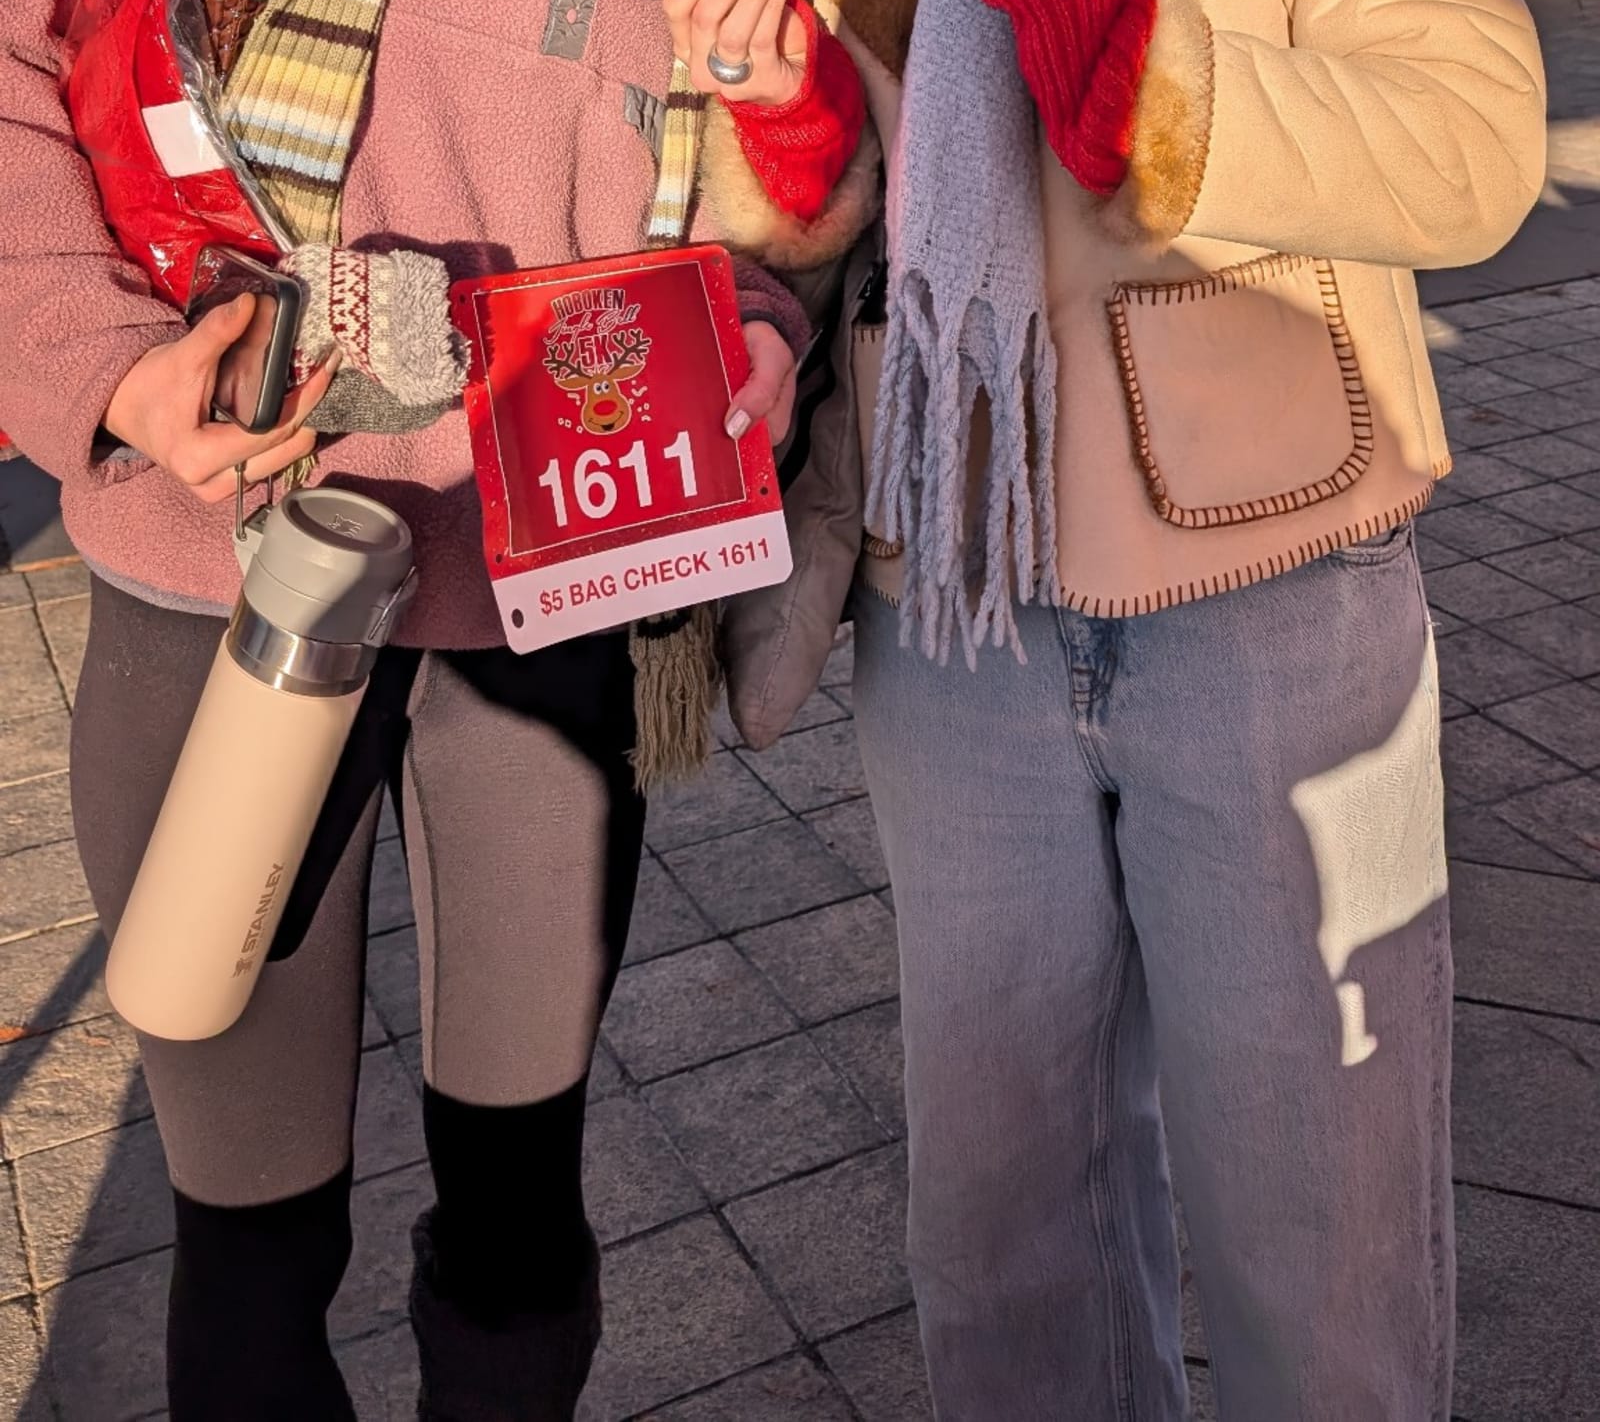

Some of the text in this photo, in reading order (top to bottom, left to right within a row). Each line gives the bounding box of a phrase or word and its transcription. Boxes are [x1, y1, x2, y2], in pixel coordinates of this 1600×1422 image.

[543, 304, 641, 344] Jingle Bell
[551, 288, 626, 321] HOBOKEN
[579, 334, 613, 367] 5K
[538, 430, 699, 528] 1611
[540, 538, 770, 617] $5 BAG CHECK 1611
[241, 863, 284, 954] STANLEY
